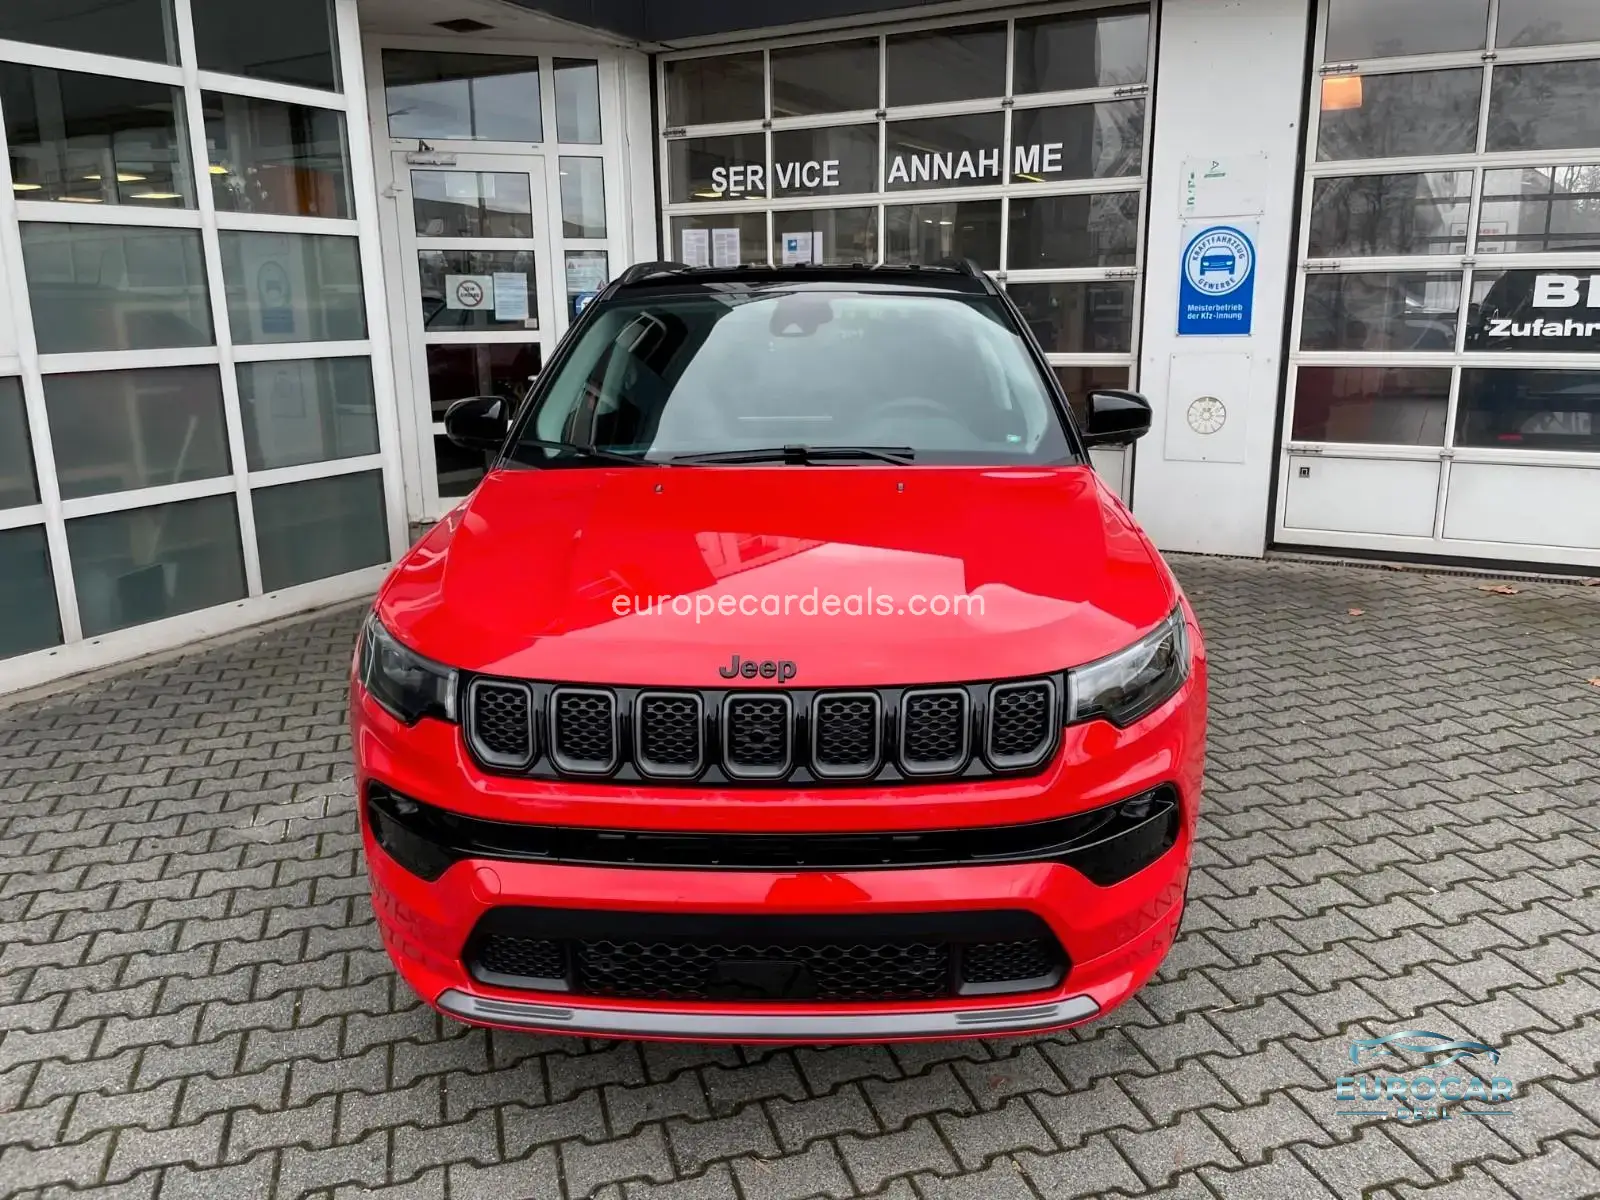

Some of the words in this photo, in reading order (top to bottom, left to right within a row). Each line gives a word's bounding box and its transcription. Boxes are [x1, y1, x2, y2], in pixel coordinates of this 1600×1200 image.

[1192, 235, 1246, 261] KRAFTFAHRZEUG
[1198, 278, 1236, 290] GEWERBE
[1187, 303, 1243, 312] Meisterbetrieb
[1187, 312, 1200, 320] der
[1488, 318, 1600, 337] Zufahr
[718, 655, 797, 683] Jeep
